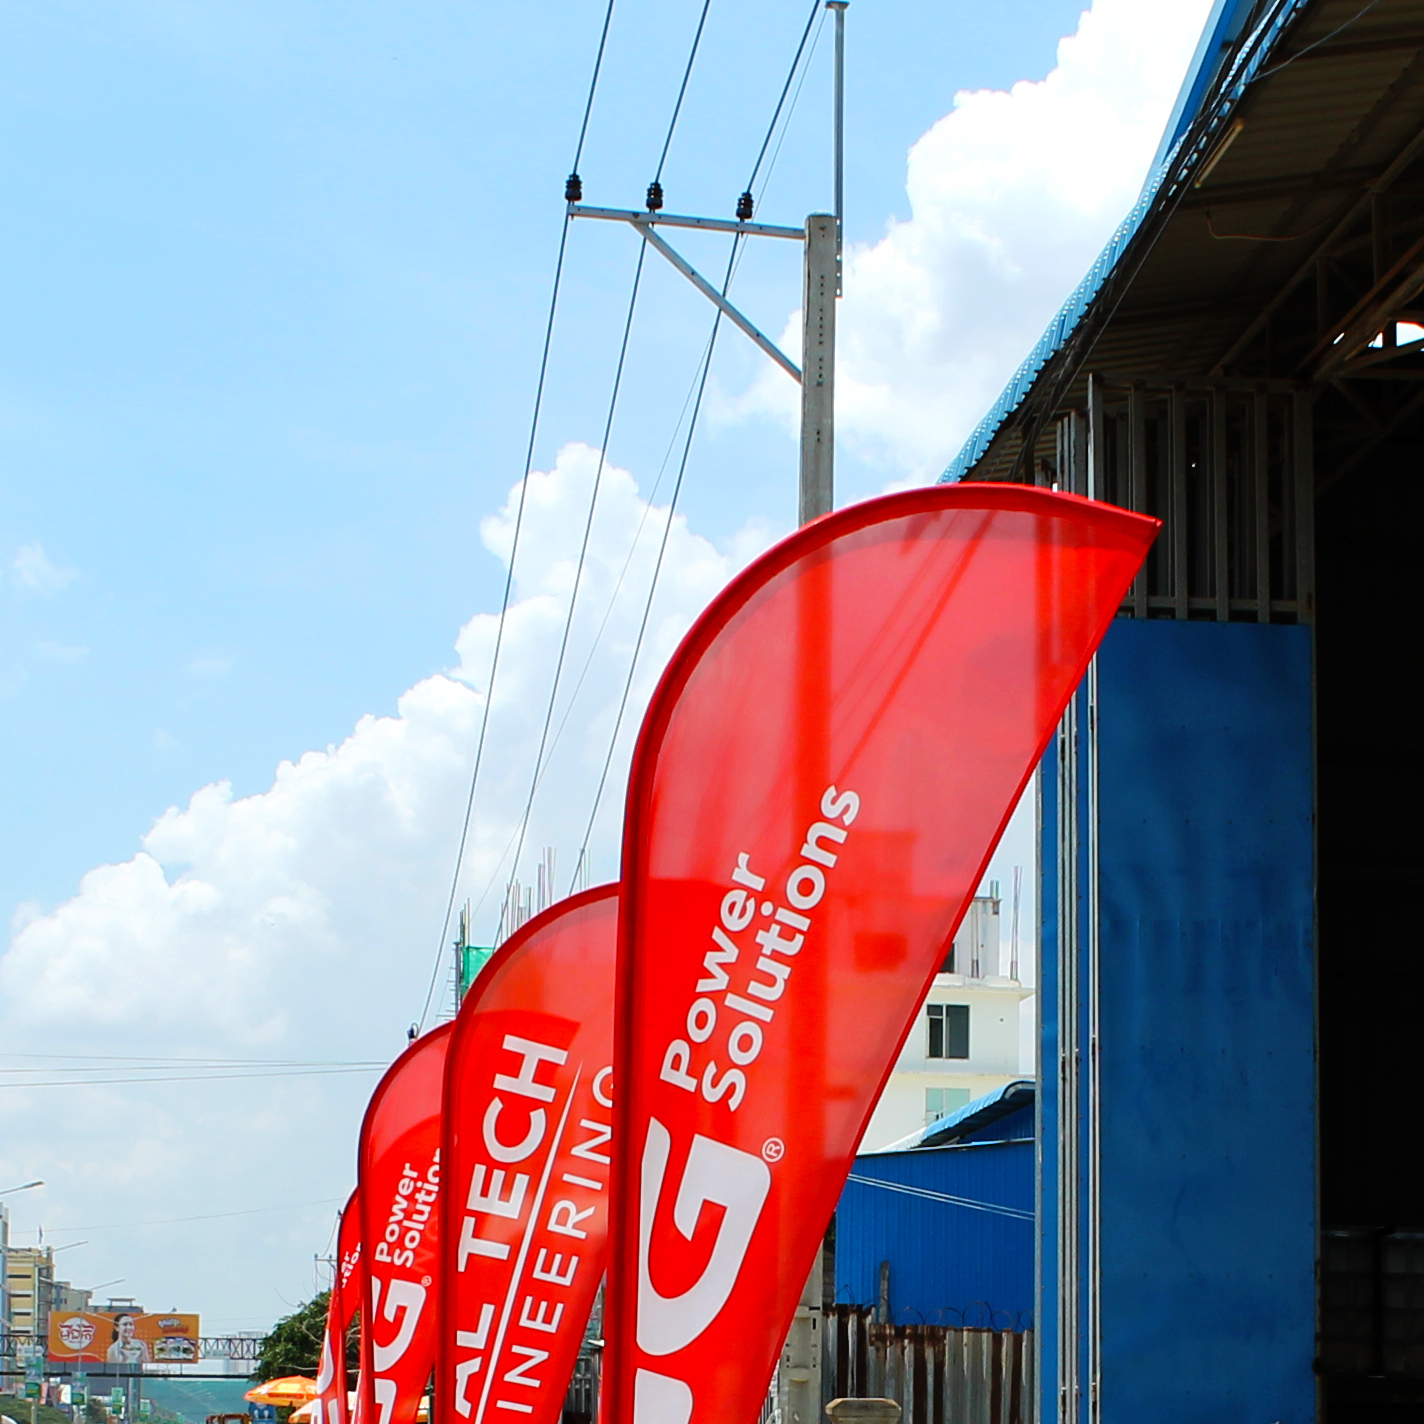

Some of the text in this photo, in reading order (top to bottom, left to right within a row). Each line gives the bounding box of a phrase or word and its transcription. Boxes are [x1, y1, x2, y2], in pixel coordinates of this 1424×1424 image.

[659, 851, 766, 1093] Power
[701, 784, 861, 1113] Solutions
[374, 1162, 419, 1263] Power
[457, 1034, 570, 1274] TECH
